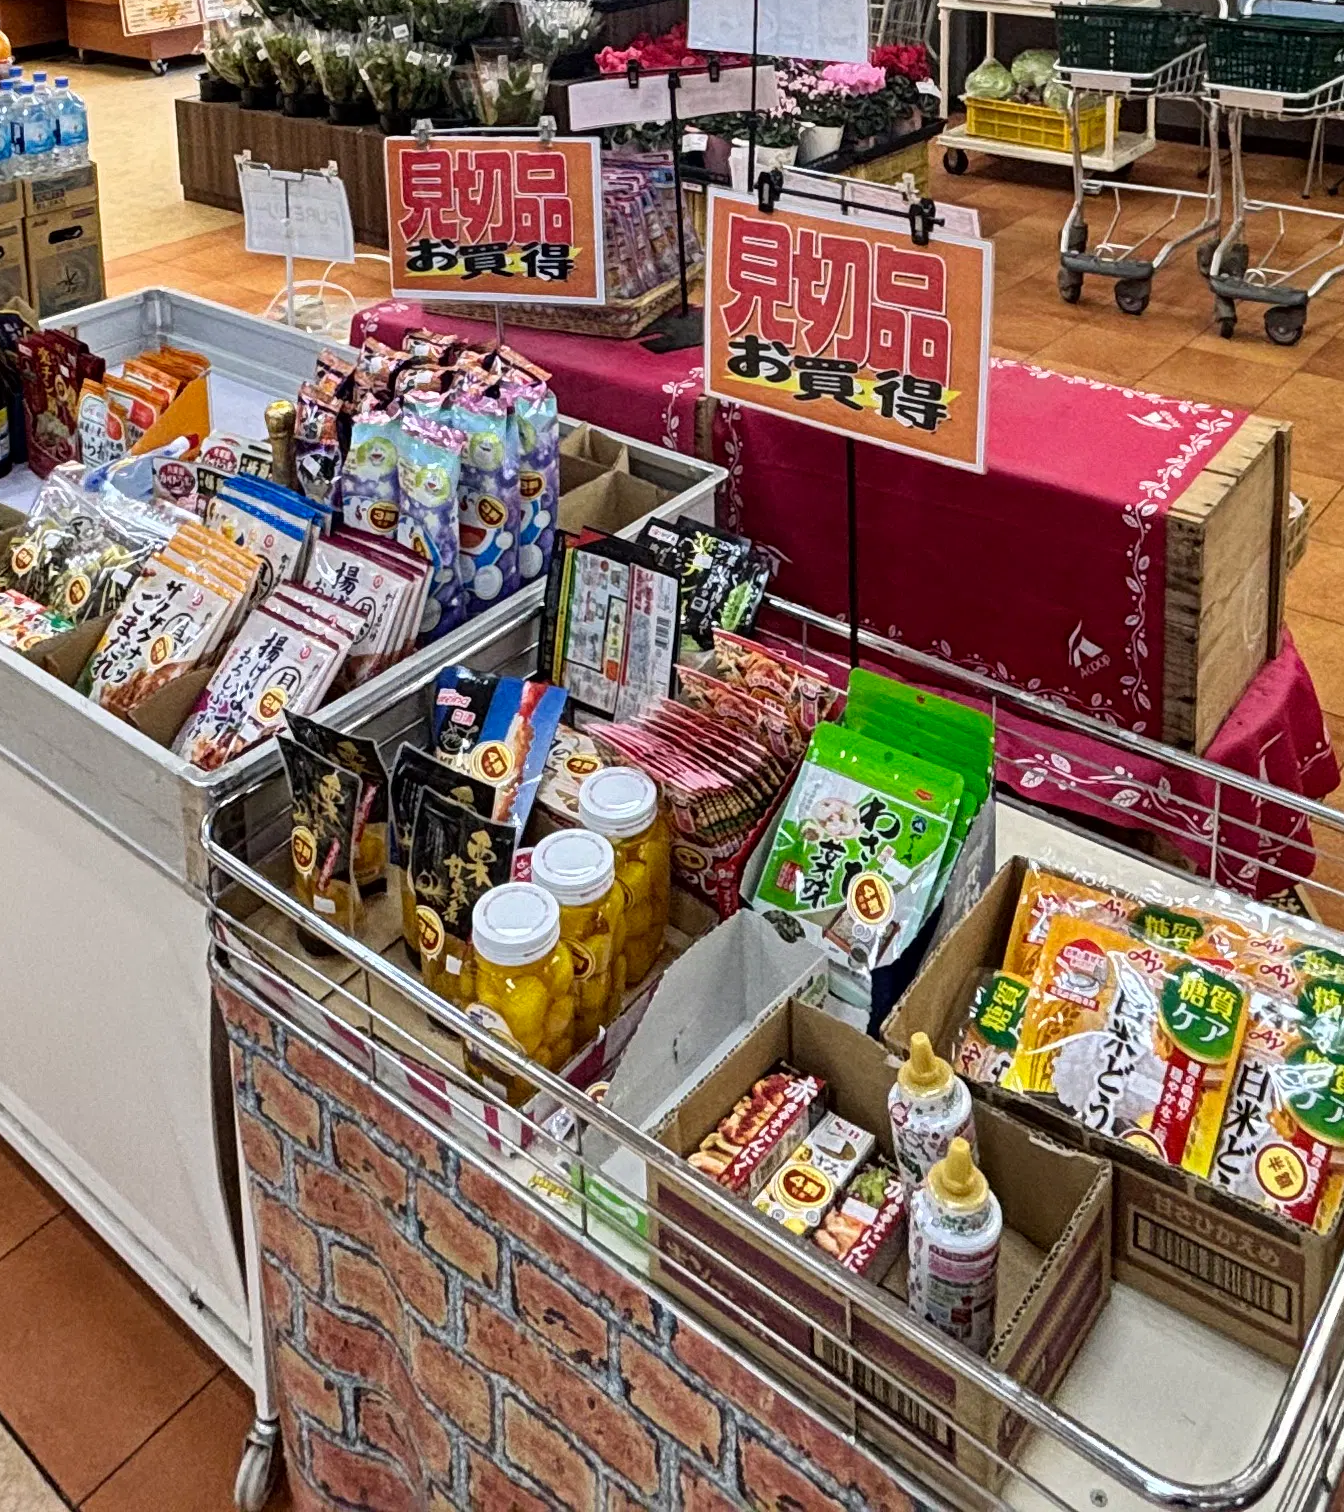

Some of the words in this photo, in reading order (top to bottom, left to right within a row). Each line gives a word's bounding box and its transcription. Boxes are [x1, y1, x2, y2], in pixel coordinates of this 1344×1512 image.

[399, 149, 574, 246] 見切品
[406, 237, 577, 281] お買得
[721, 212, 953, 389] 見切品
[727, 334, 951, 432] お買得
[92, 591, 162, 682] ごまだれ
[980, 980, 1024, 1040] 糖質
[1171, 1002, 1231, 1043] ケア
[1178, 971, 1239, 1024] 糖質
[1217, 1061, 1272, 1186] 白米ど
[788, 1174, 824, 1197] 4割
[1266, 1154, 1297, 1190] 半額
[1154, 1194, 1282, 1268] 甘さひかえめ
